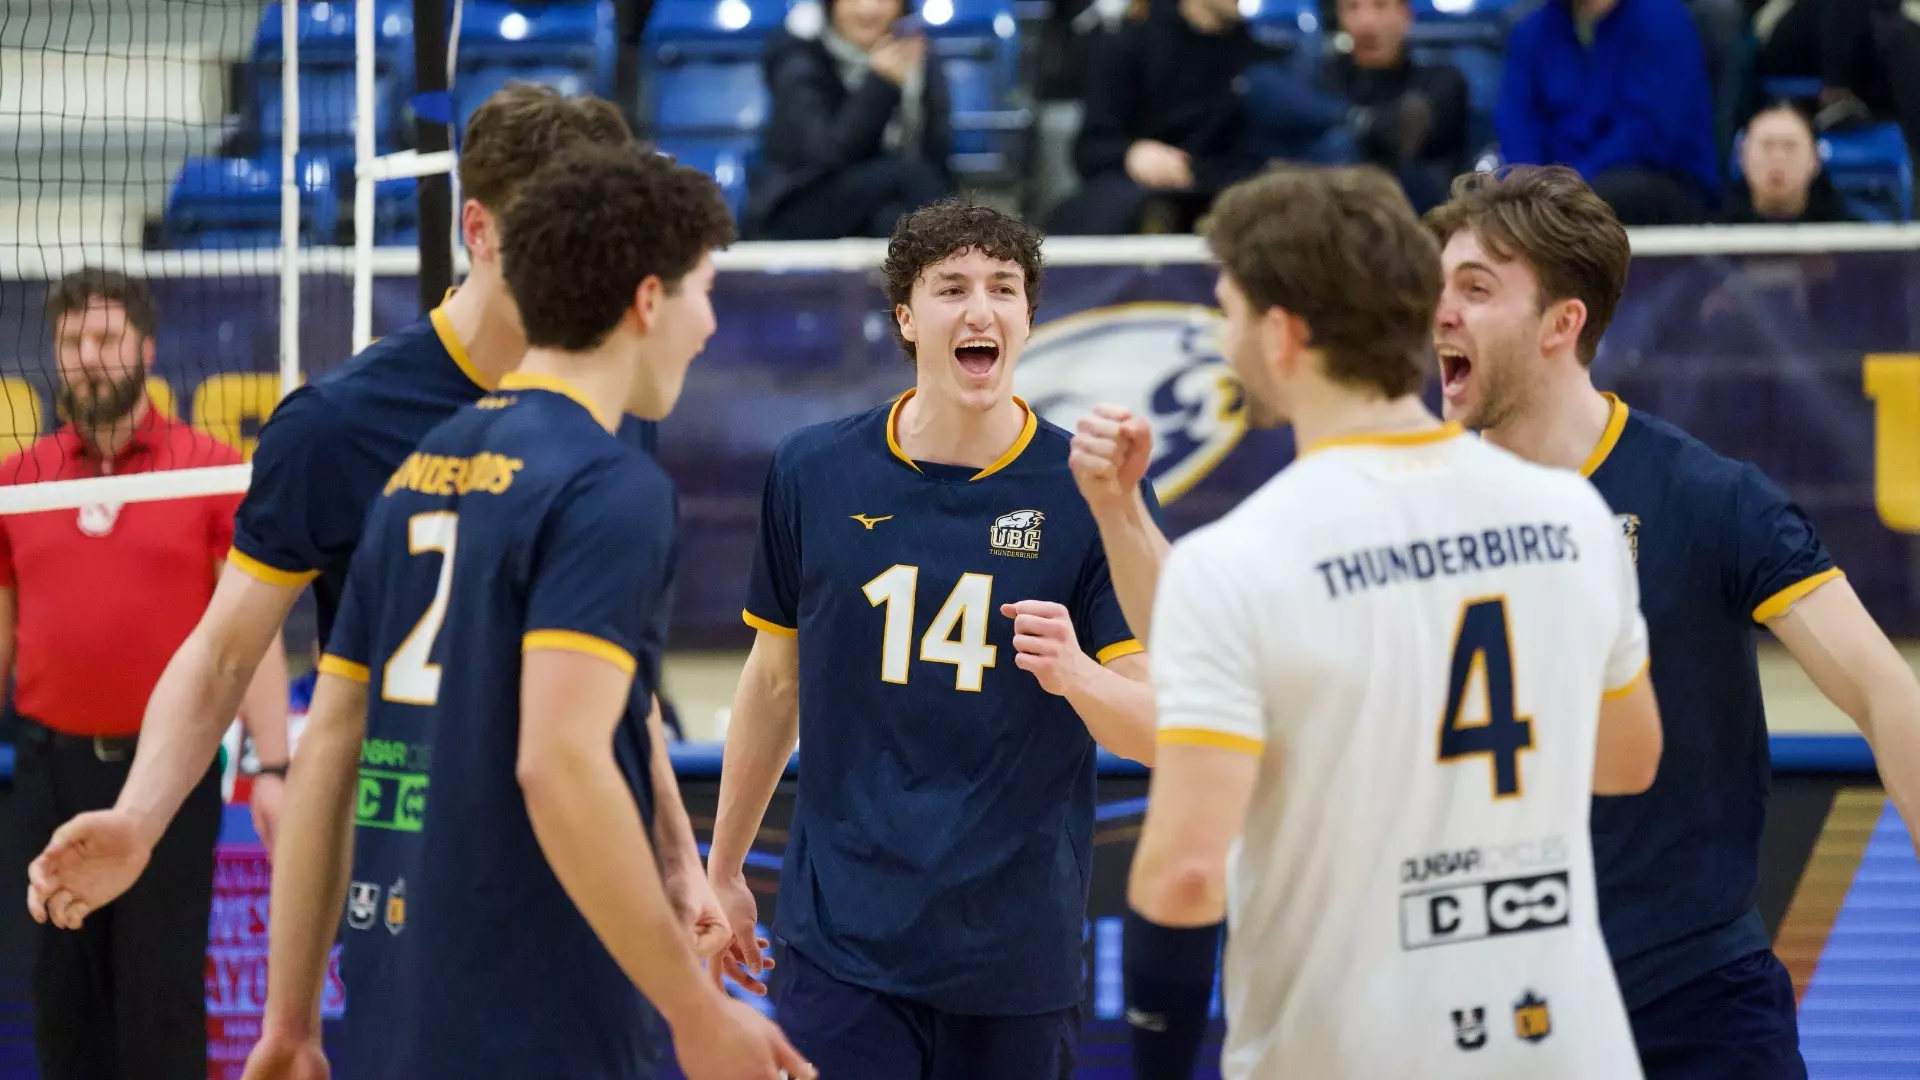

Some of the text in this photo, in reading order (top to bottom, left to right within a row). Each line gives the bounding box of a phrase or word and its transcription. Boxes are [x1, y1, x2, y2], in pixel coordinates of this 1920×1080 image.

[988, 548, 1039, 560] THUNDERBIRDS
[990, 525, 1041, 552] UBC
[1314, 523, 1580, 600] THUNDERBIRDS
[381, 511, 459, 706] 2
[861, 563, 998, 693] 14
[1434, 592, 1538, 803] 4
